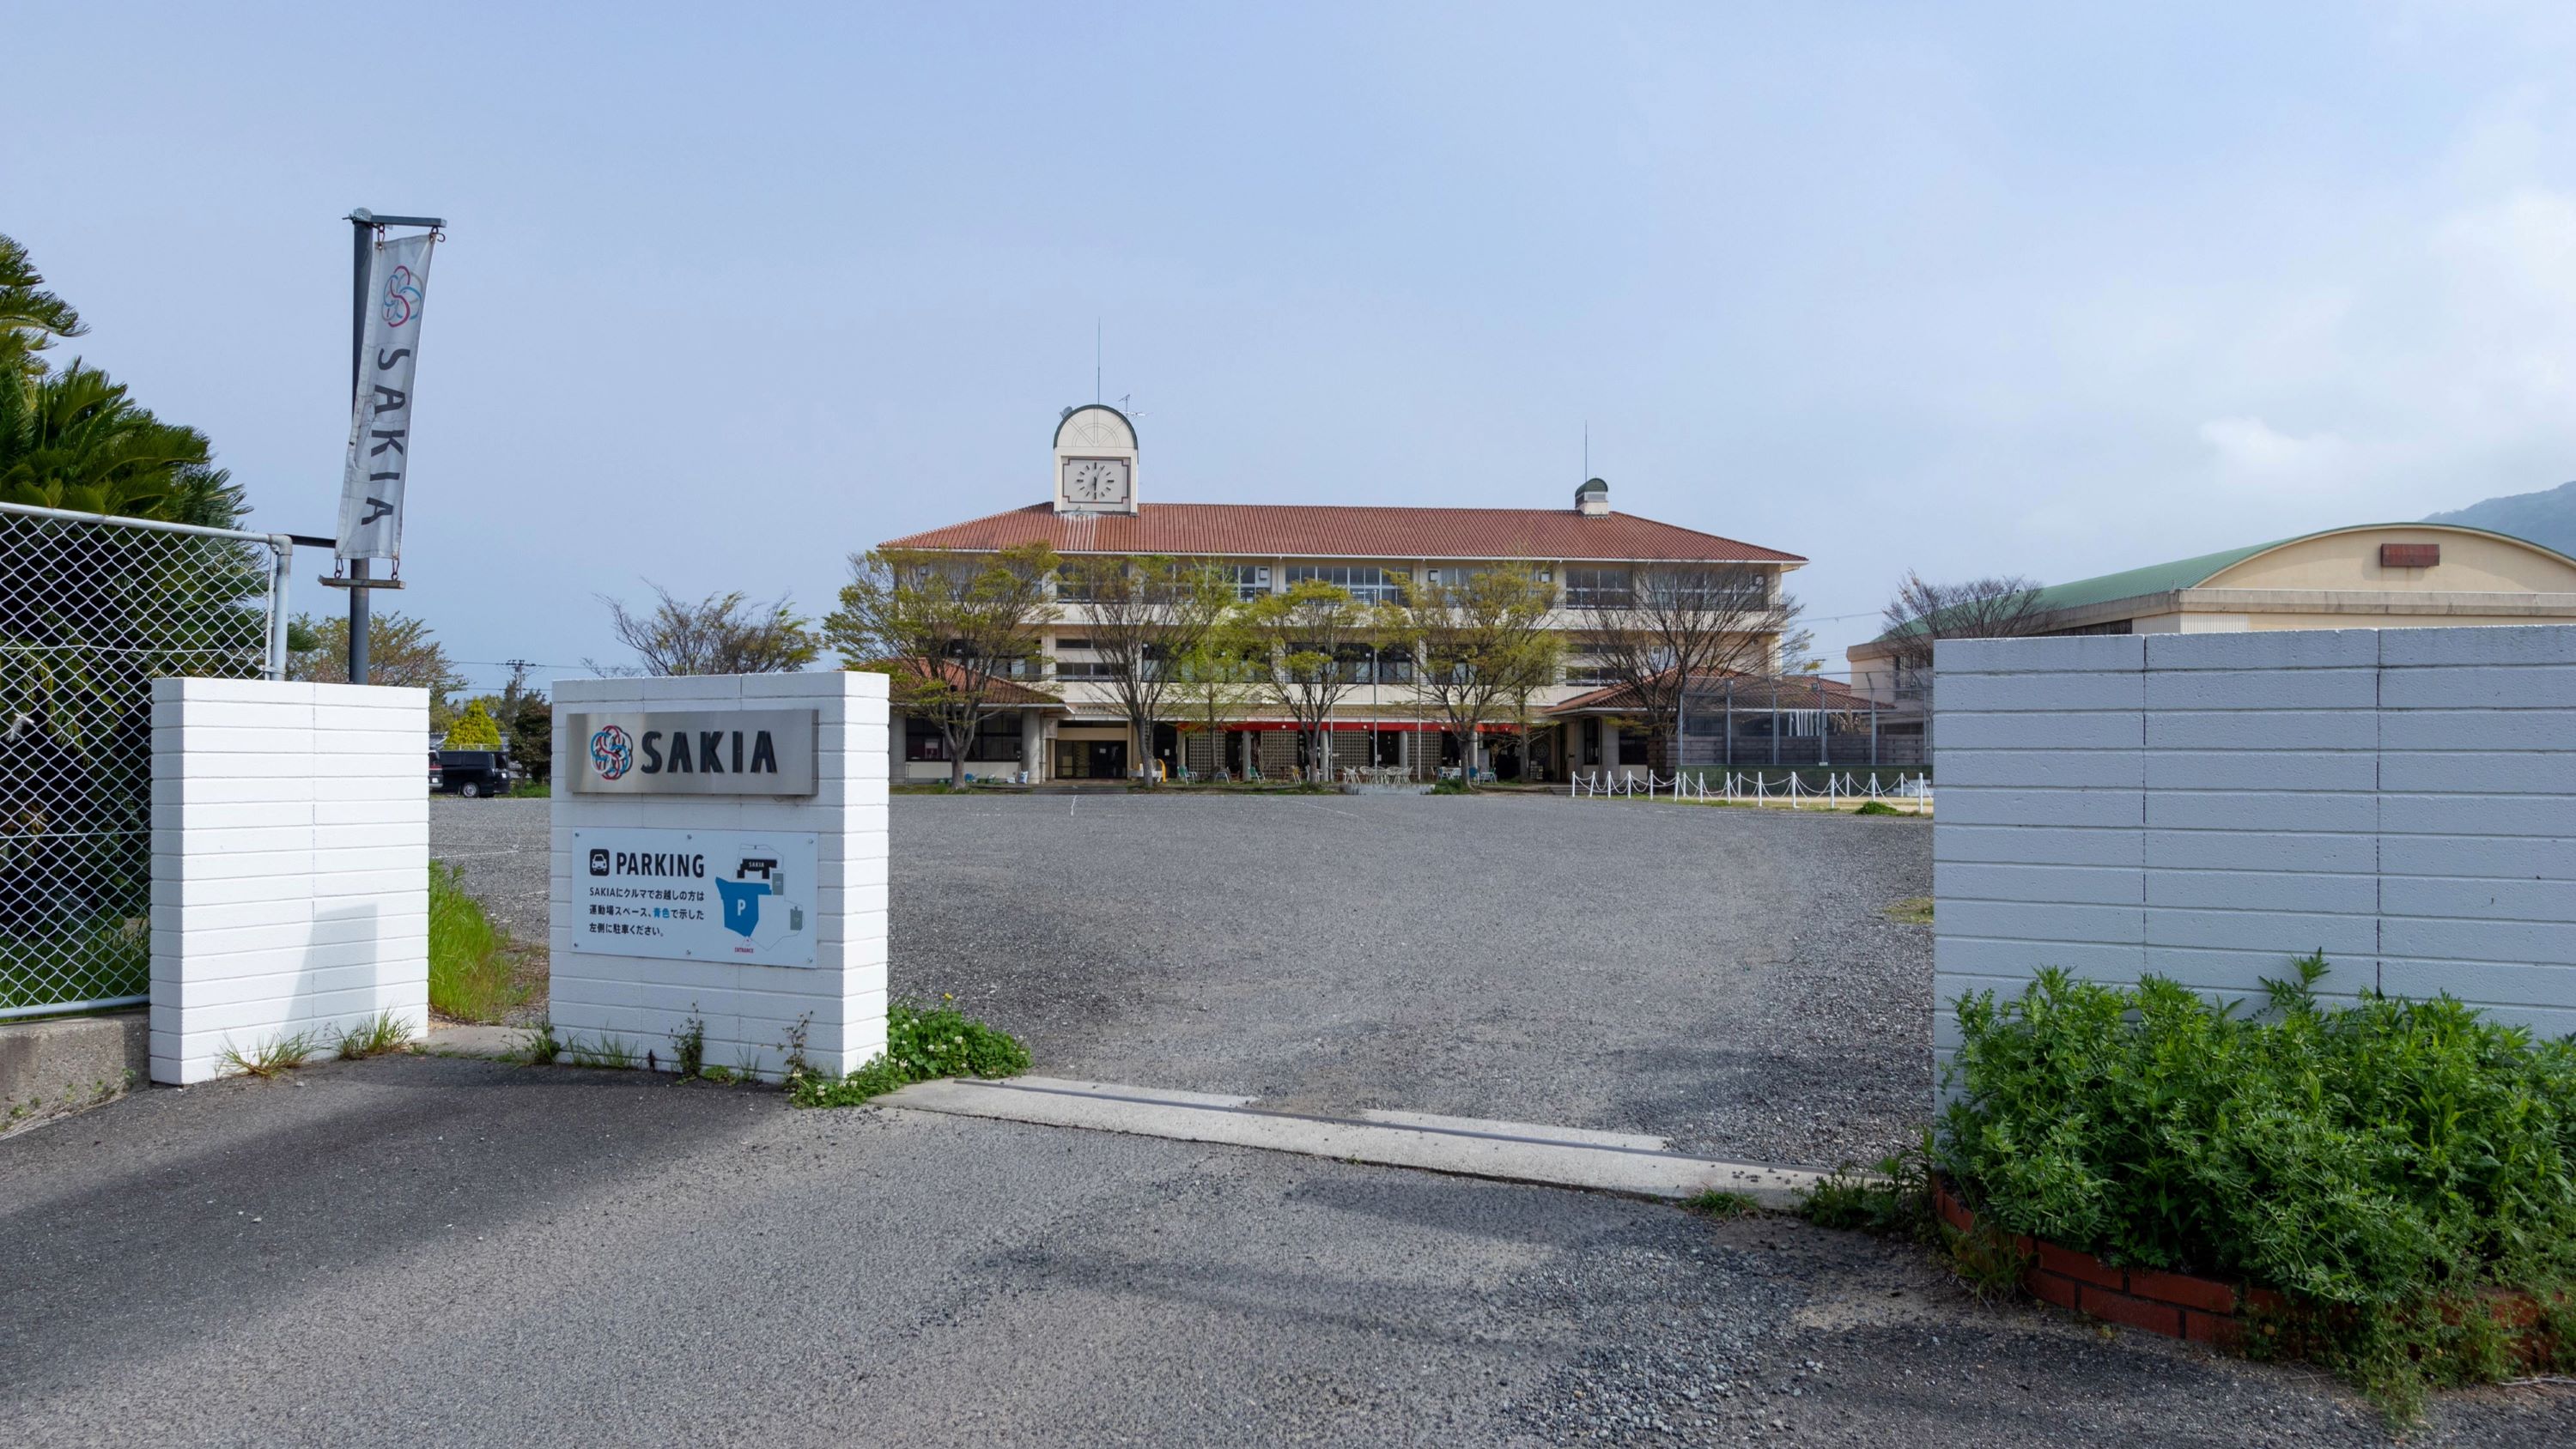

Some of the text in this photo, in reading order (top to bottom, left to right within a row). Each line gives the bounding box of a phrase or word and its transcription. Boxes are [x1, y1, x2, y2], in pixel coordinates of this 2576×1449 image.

[361, 348, 411, 525] SAKIA
[641, 731, 778, 773] SAKIA
[617, 852, 704, 878] PARKING
[590, 887, 704, 901] SAKIAにクルマでお越しの方は
[589, 904, 704, 920] 運動場スペース、青色で示した
[738, 899, 746, 916] P
[589, 922, 664, 937] 左側に駐車ください。
